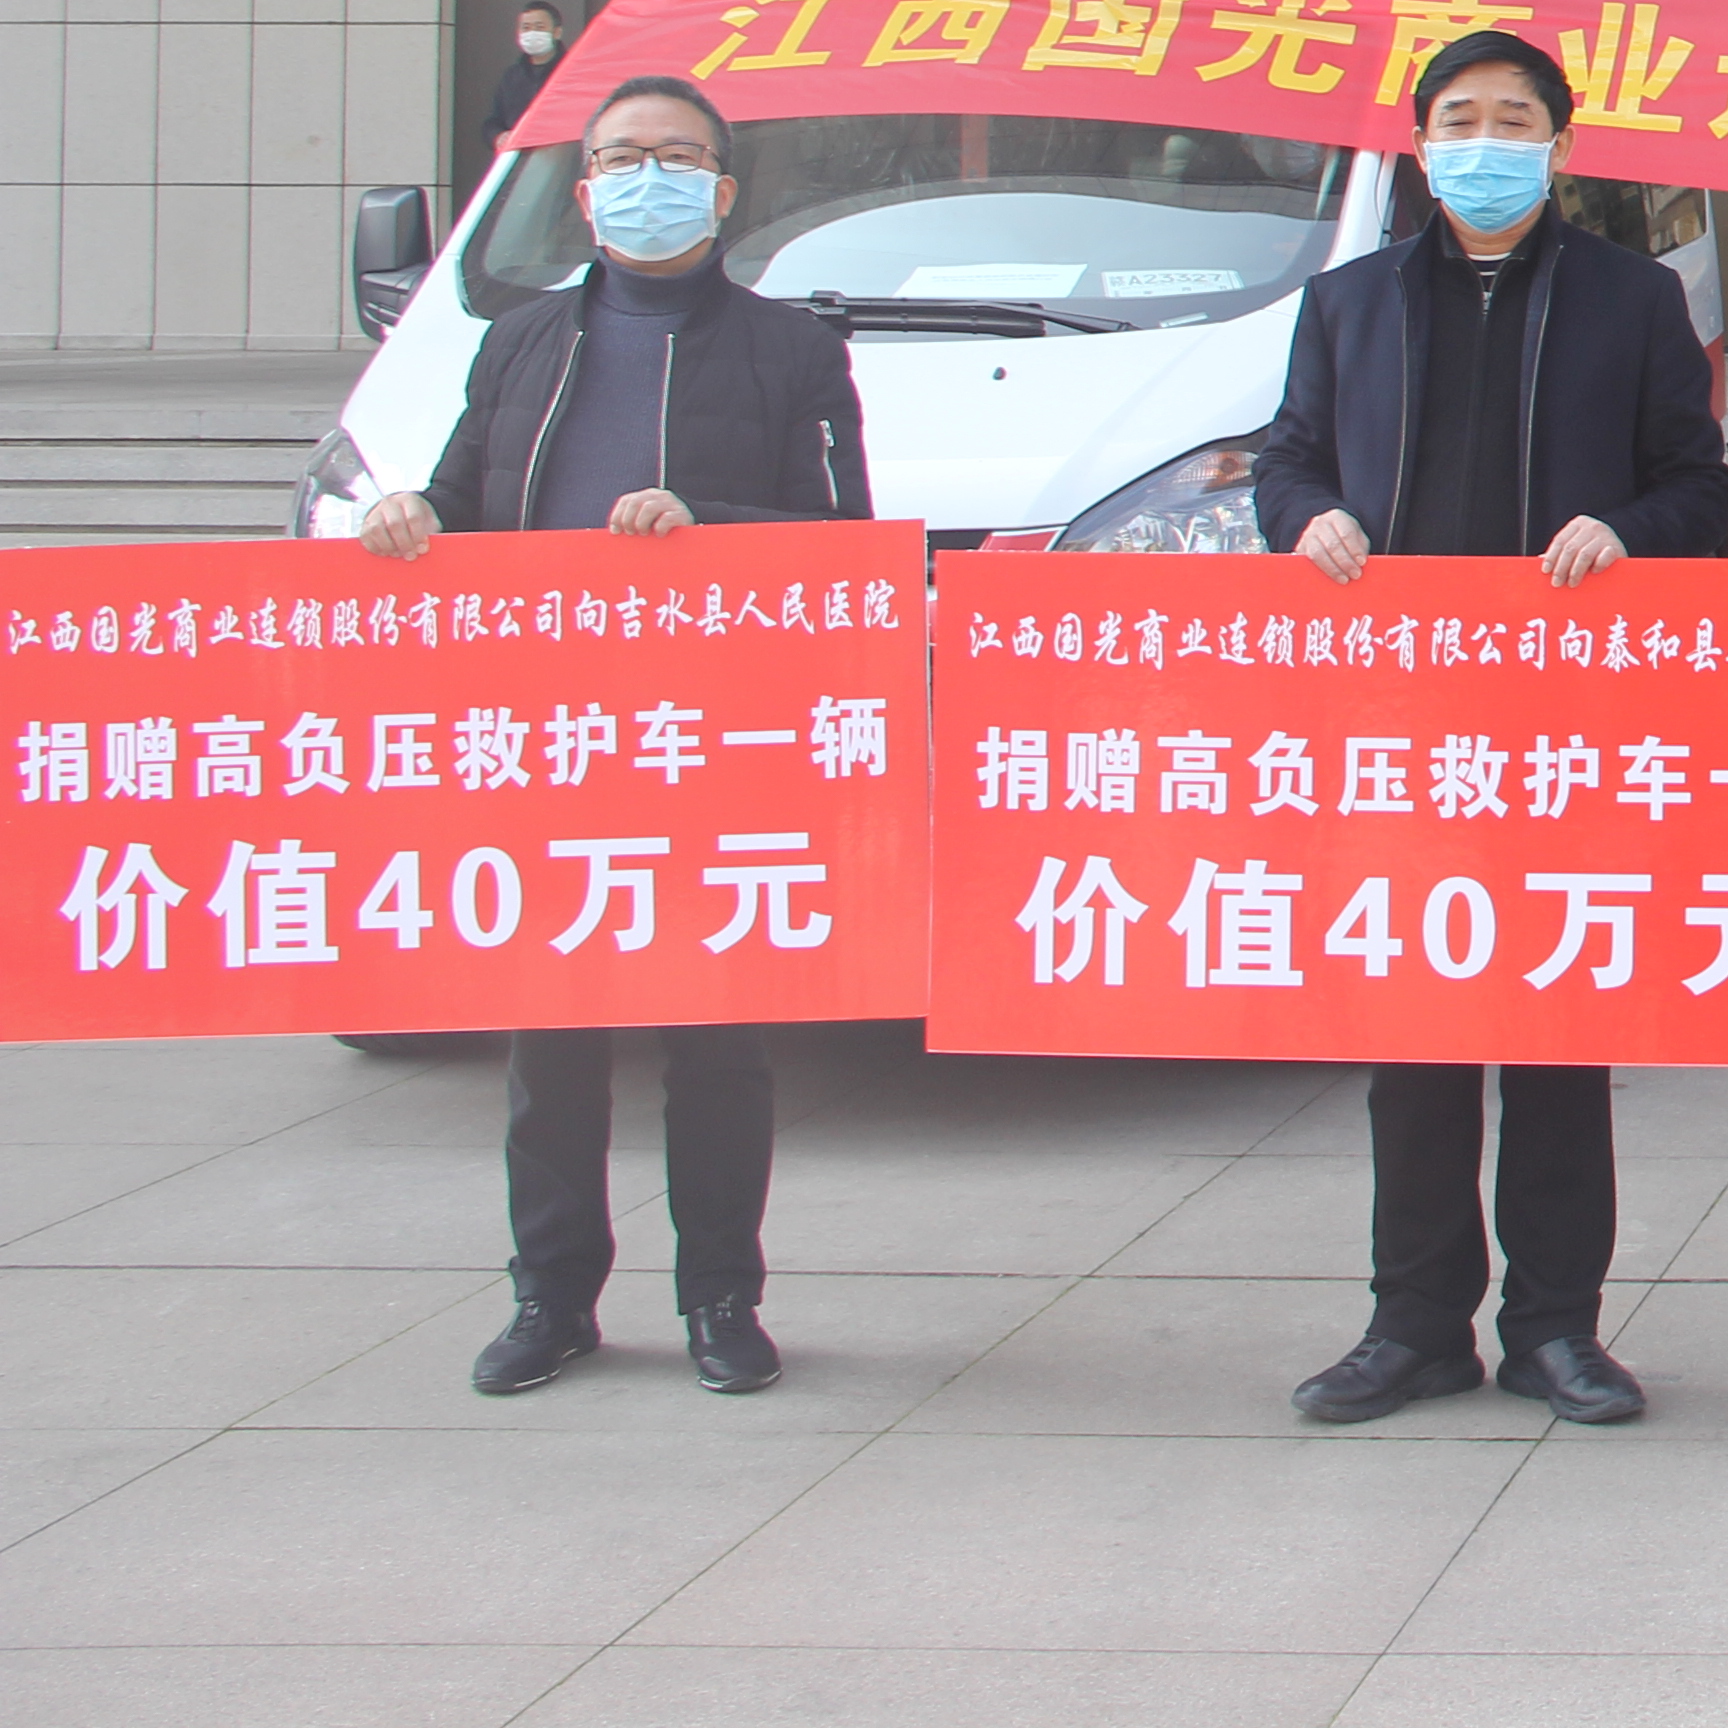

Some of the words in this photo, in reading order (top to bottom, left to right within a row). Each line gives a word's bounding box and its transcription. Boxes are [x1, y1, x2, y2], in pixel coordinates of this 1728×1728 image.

[9, 579, 898, 657] 江西国光商业连锁股份有限公司向吉水县人民医院
[19, 696, 886, 801] 捐赠高负压救护车一辆
[60, 832, 832, 970] 价值40万元
